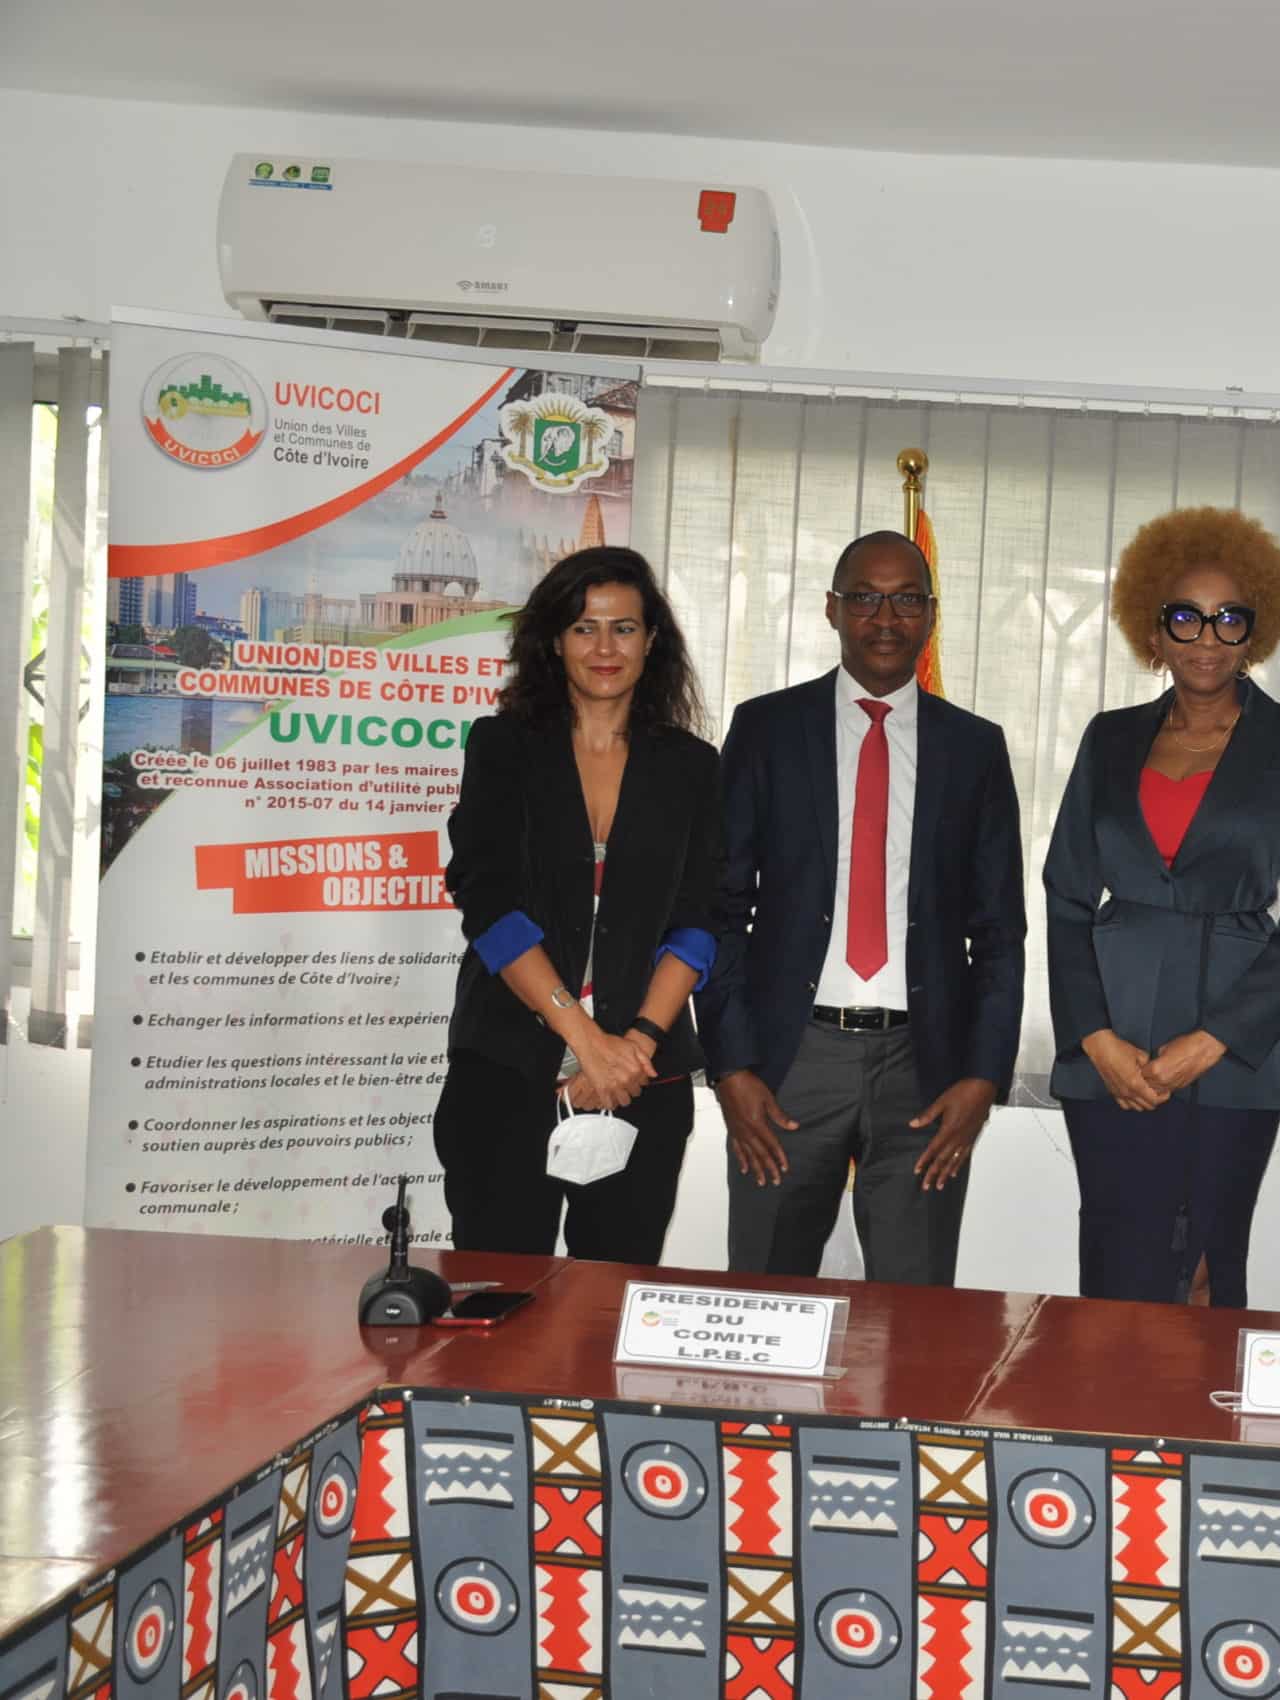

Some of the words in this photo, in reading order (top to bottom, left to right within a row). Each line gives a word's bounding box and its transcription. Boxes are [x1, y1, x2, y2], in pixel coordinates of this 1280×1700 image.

[275, 381, 381, 415] UVICOCI
[274, 418, 308, 433] Union
[311, 420, 332, 434] des
[335, 423, 368, 438] Villes
[164, 439, 241, 465] UVICOCI
[274, 433, 286, 443] et
[288, 433, 353, 451] Communes
[356, 438, 371, 451] de
[273, 447, 309, 464] Côte
[313, 450, 369, 469] d'Ivoire
[237, 644, 320, 666] UNION
[328, 649, 377, 670] DES
[386, 652, 470, 675] VILLES
[477, 657, 506, 677] ET
[179, 671, 330, 698] COMMUNES
[339, 680, 371, 700] DE
[380, 679, 444, 704] CÔTE
[453, 685, 502, 705] D'IV
[269, 712, 471, 750] UVICOCI
[134, 752, 190, 769] Créée
[193, 755, 209, 769] le
[215, 756, 237, 770] 06
[241, 756, 290, 773] juillet
[298, 758, 337, 773] 1983
[342, 762, 370, 778] par
[374, 762, 399, 776] les
[404, 763, 459, 777] maires
[141, 772, 159, 786] et
[165, 774, 249, 789] reconnue
[254, 777, 353, 792] Association
[359, 780, 422, 795] d'utilité
[426, 783, 460, 797] publ
[267, 796, 333, 811] 2015-07
[338, 798, 359, 812] du
[365, 799, 385, 813] 14
[388, 800, 445, 816] janvier
[244, 840, 383, 879] MISSIONS
[388, 844, 409, 869] &
[150, 950, 202, 965] Etablir
[206, 952, 222, 965] et
[225, 951, 309, 968] développer
[312, 950, 337, 965] des
[340, 951, 374, 965] liens
[378, 952, 396, 965] de
[149, 973, 165, 985] et
[168, 972, 189, 985] les
[193, 974, 275, 986] communes
[278, 971, 296, 985] de
[300, 971, 333, 985] Côte
[148, 1013, 222, 1030] Echanger
[225, 1014, 245, 1027] les
[249, 1012, 345, 1027] informations
[348, 1013, 363, 1026] et
[365, 1012, 385, 1026] les
[388, 1011, 449, 1029] expérien
[146, 1055, 202, 1069] Etudier
[206, 1055, 227, 1069] les
[231, 1053, 302, 1071] questions
[305, 1053, 388, 1066] intéressant
[390, 1052, 403, 1066] la
[407, 1052, 427, 1065] vie
[430, 1053, 445, 1065] et
[145, 1075, 267, 1090] administrations
[270, 1074, 320, 1088] locales
[324, 1073, 339, 1087] et
[342, 1073, 355, 1087] le
[358, 1072, 423, 1087] bien-être
[143, 1117, 237, 1132] Coordonner
[240, 1116, 260, 1130] les
[263, 1113, 345, 1131] aspirations
[349, 1114, 364, 1127] et
[366, 1113, 386, 1126] les
[389, 1111, 433, 1128] object
[142, 1138, 200, 1153] soutien
[203, 1137, 256, 1154] auprès
[259, 1136, 283, 1149] des
[286, 1134, 351, 1151] pouvoirs
[140, 1179, 214, 1194] Favoriser
[217, 1178, 232, 1192] le
[234, 1176, 348, 1192] développement
[351, 1173, 370, 1187] de
[640, 1291, 817, 1314] PRESIDENTE
[705, 1314, 745, 1326] DU
[673, 1329, 782, 1347] COMITE
